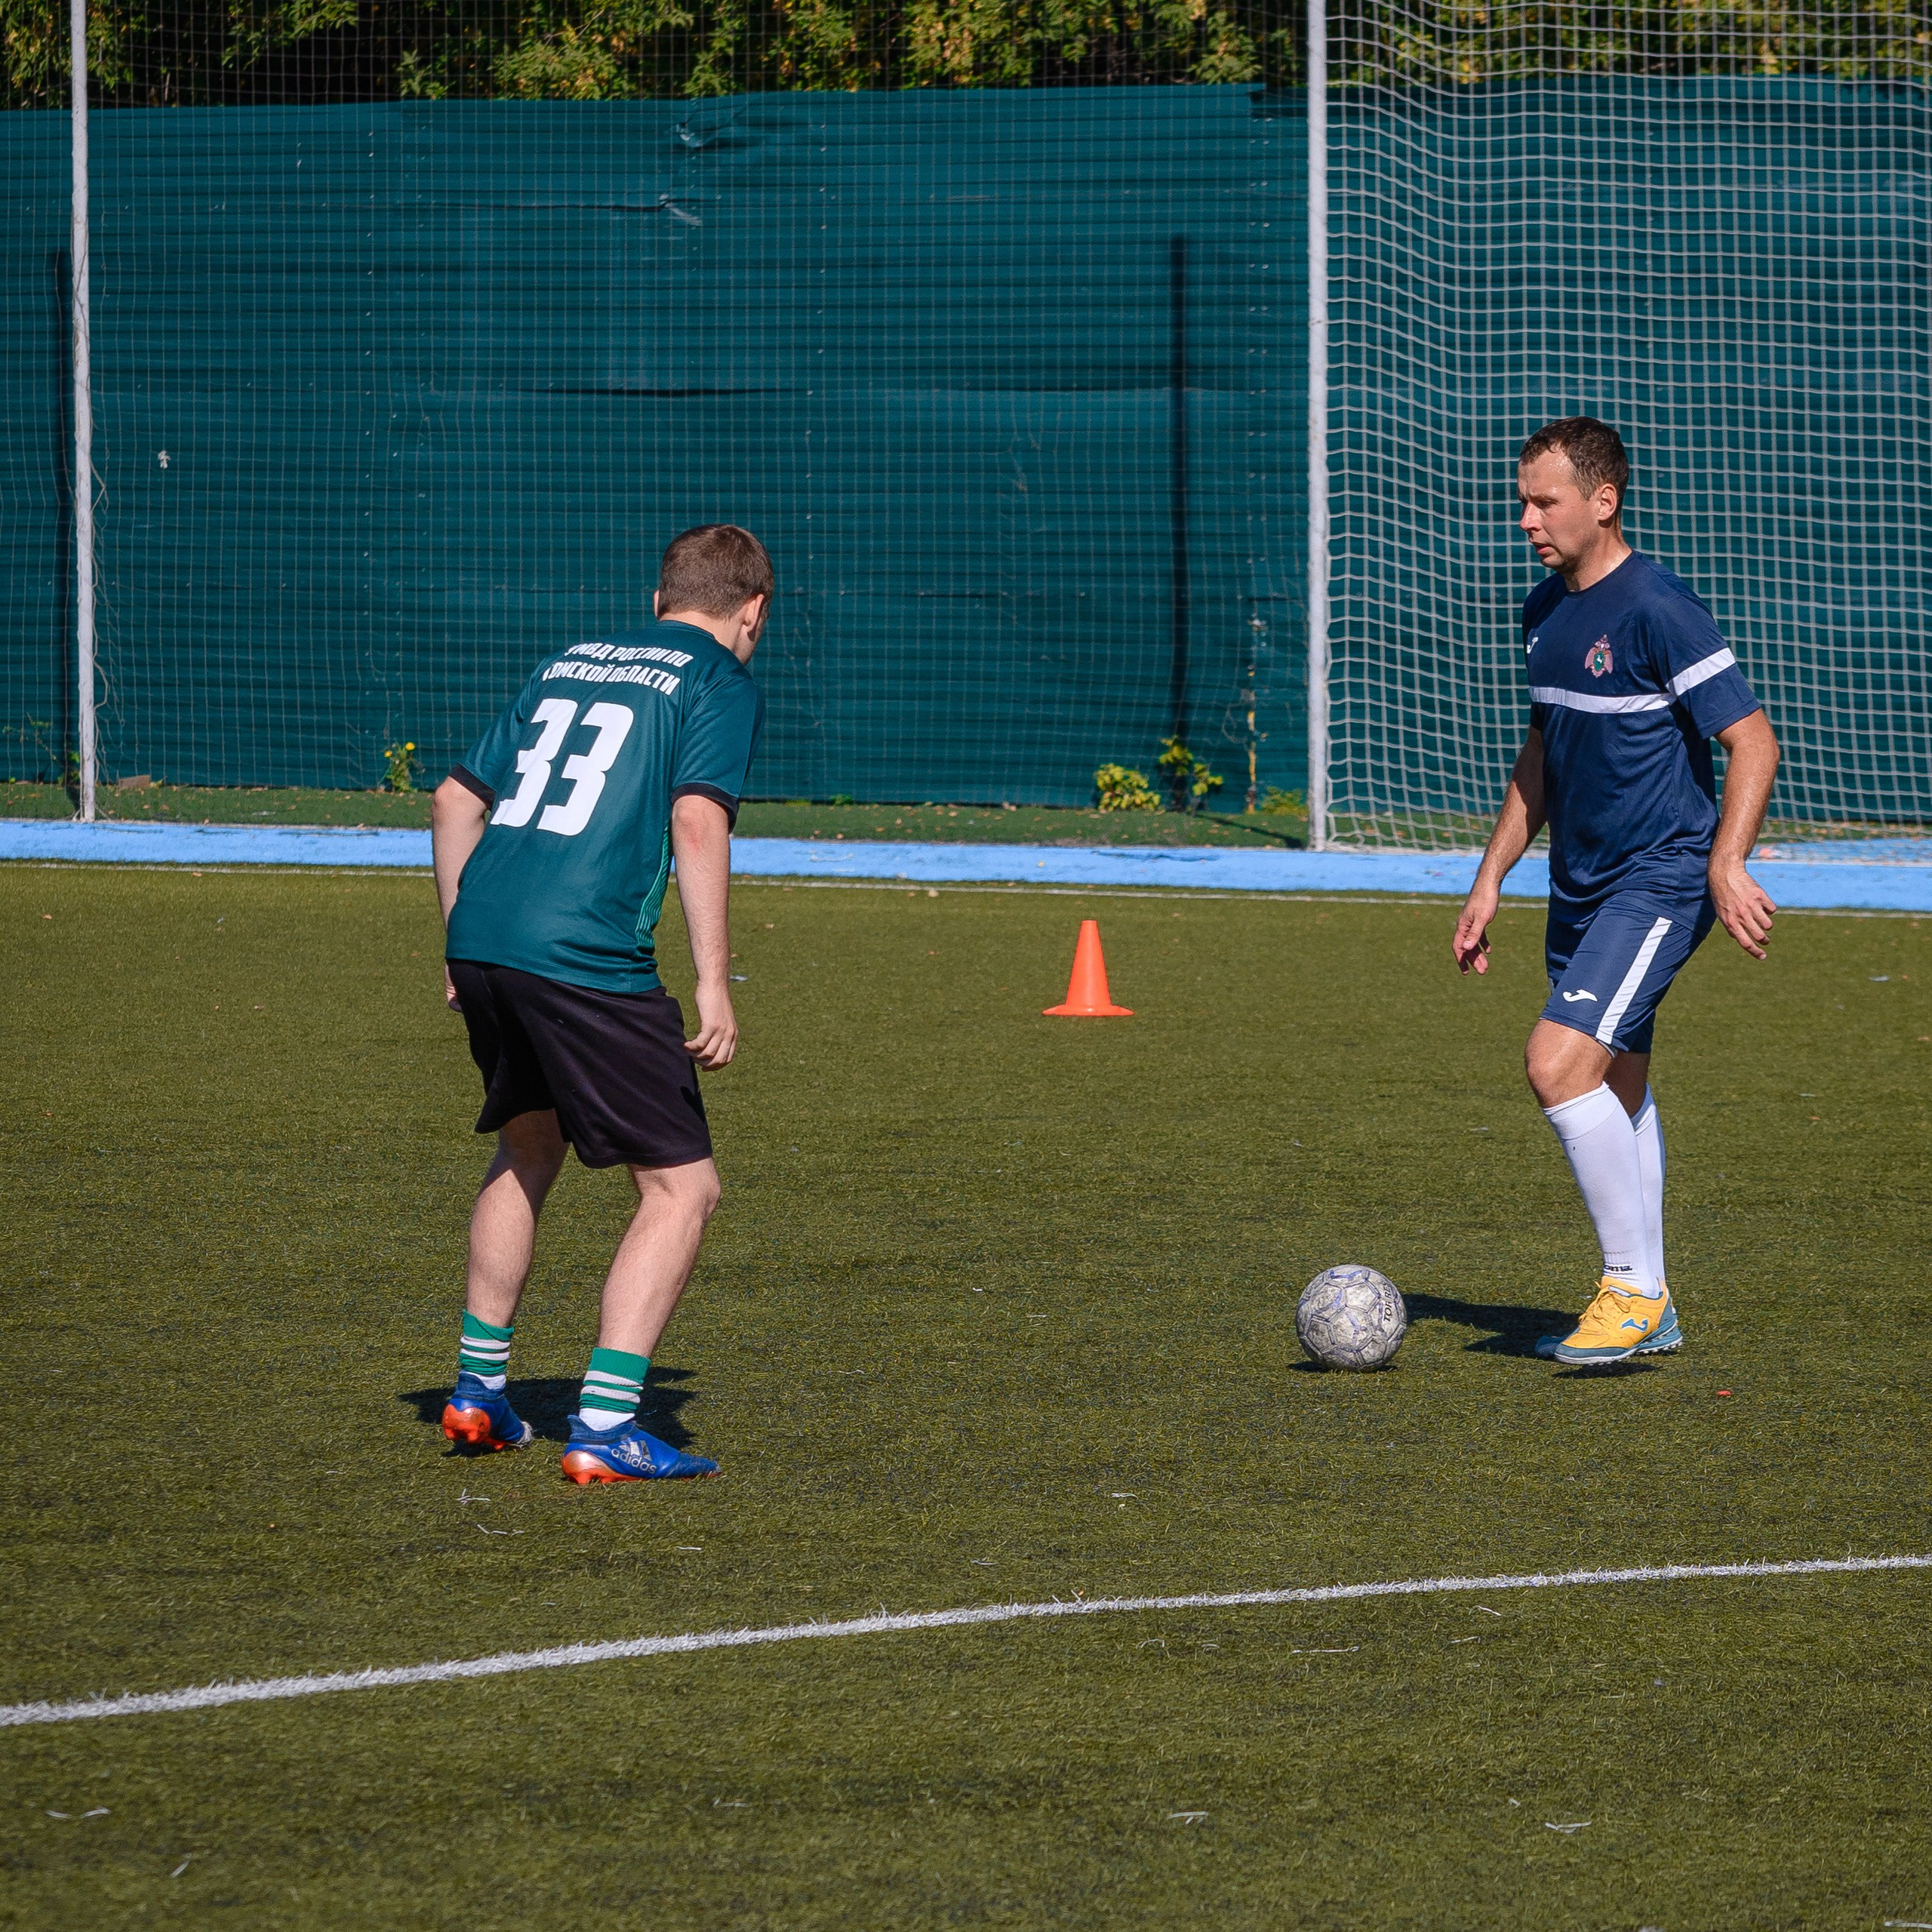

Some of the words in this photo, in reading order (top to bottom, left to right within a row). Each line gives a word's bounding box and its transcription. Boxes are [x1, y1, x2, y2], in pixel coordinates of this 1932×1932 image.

[608, 647, 672, 661] РОССИИ
[662, 651, 694, 668] ПО
[606, 665, 681, 696] ОБЛАСТИ
[490, 698, 634, 836] 33
[612, 1447, 657, 1474] adidas
